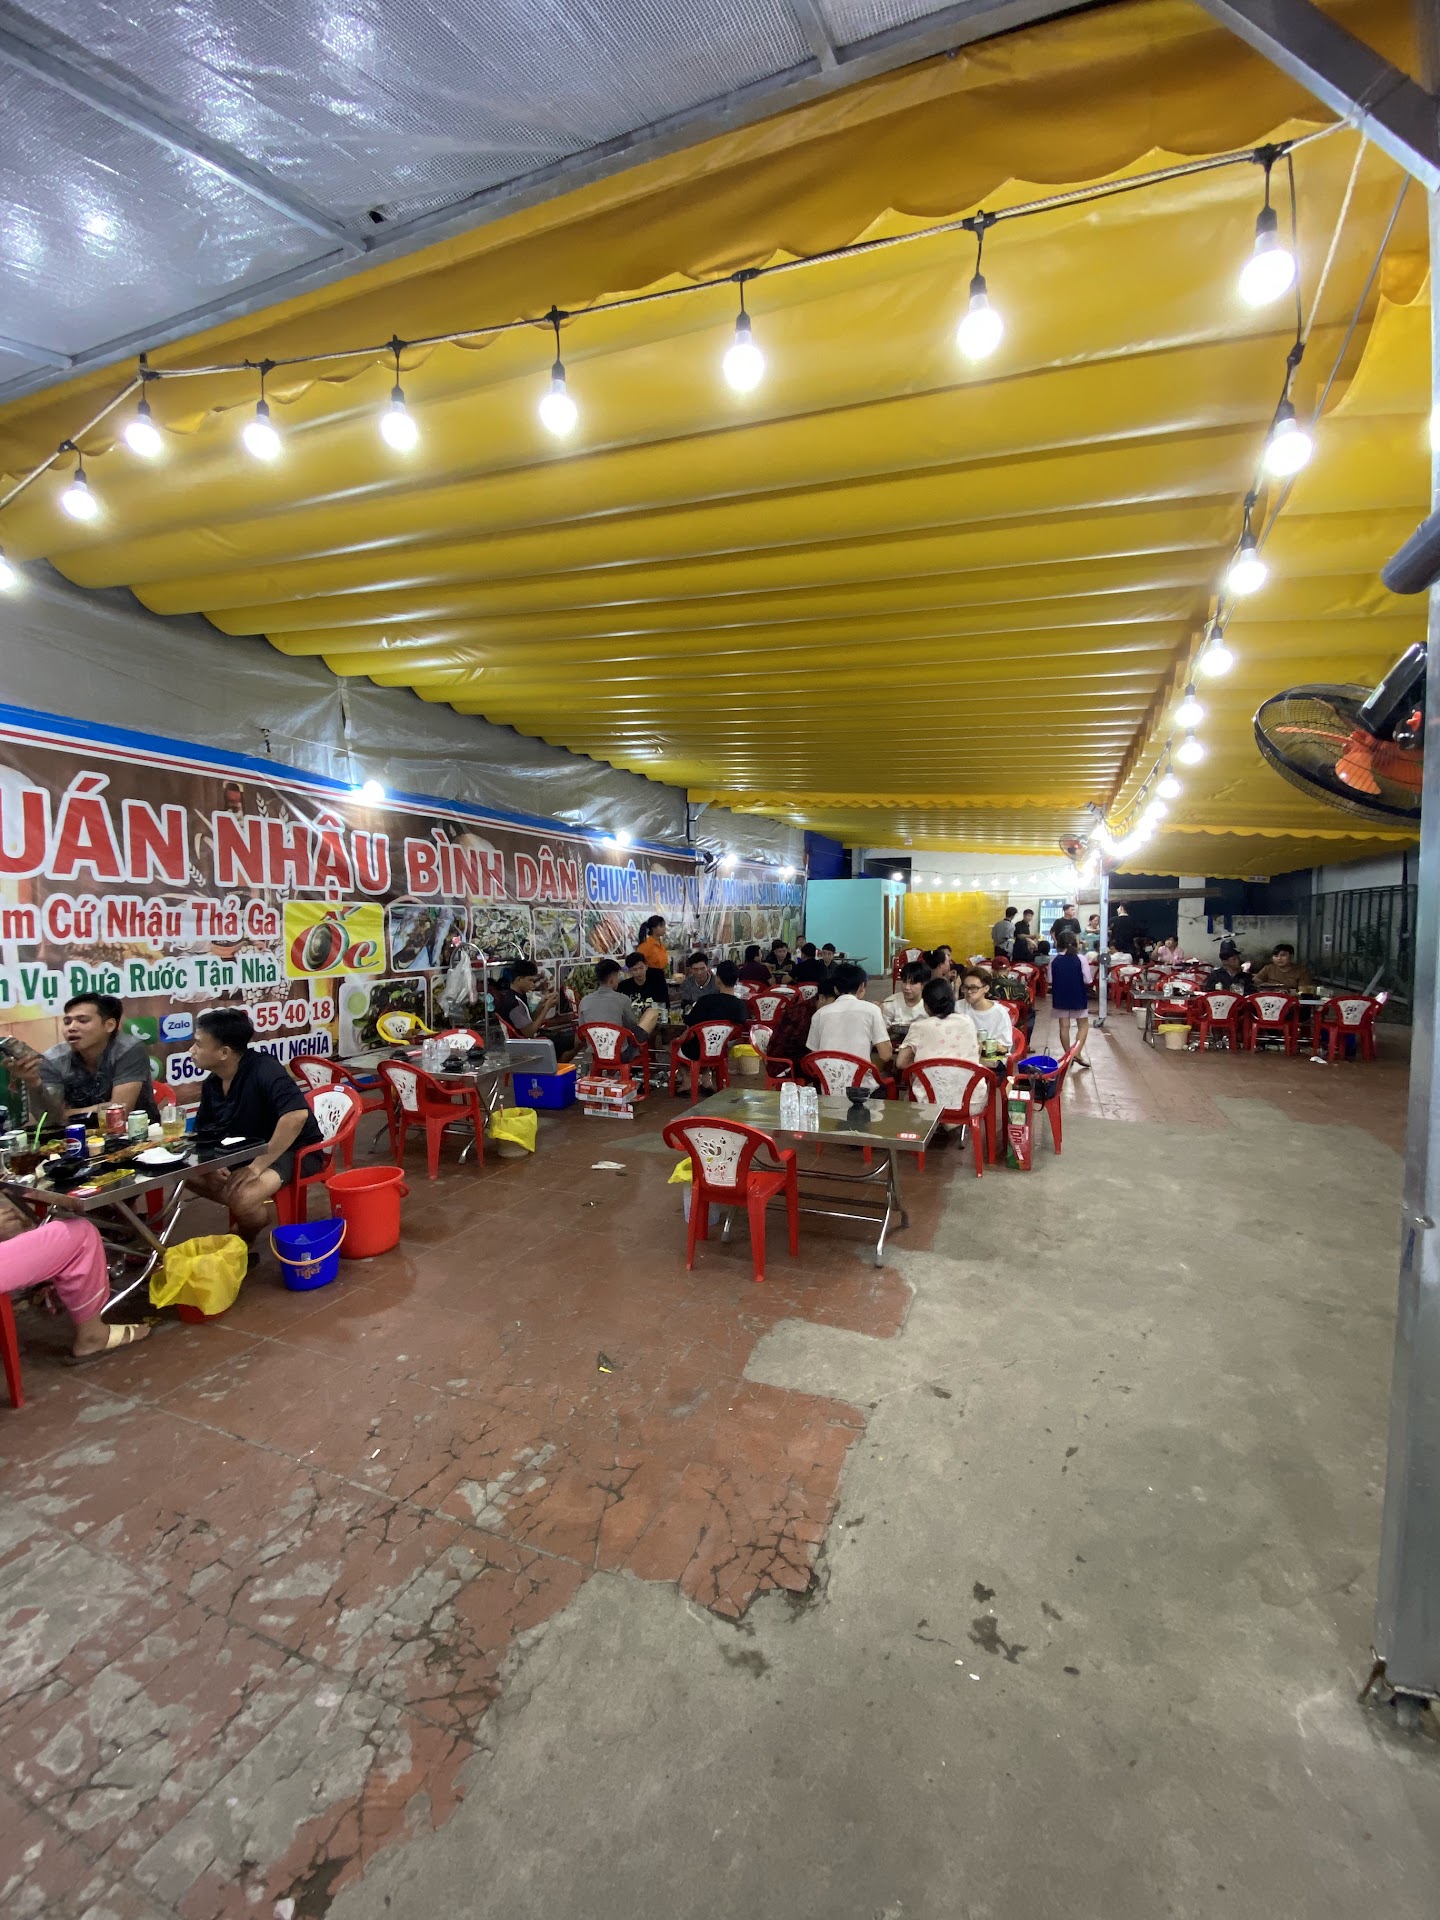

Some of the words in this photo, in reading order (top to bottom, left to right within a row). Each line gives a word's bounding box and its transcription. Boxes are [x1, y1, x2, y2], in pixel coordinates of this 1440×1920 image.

[215, 813, 389, 902] NHẬU
[407, 831, 506, 897] BÌNH
[516, 847, 579, 900] DÂN
[586, 860, 648, 904] CHUYÊN
[48, 899, 97, 939] Cứ
[107, 900, 182, 946] Nhậu
[191, 899, 238, 936] Thả
[247, 902, 277, 935] Ga
[290, 905, 378, 973] Ốc
[20, 967, 58, 1006] Vụ
[70, 965, 121, 997] Đưa
[129, 961, 188, 993] Rước
[194, 959, 233, 993] Tận
[241, 957, 277, 984] Nhà
[167, 1021, 190, 1031] Zalo
[256, 1006, 279, 1028] 55
[285, 1003, 306, 1023] 40
[312, 1000, 331, 1020] 18
[289, 1032, 329, 1060] NGHĨA
[295, 1265, 321, 1280] Tiger
